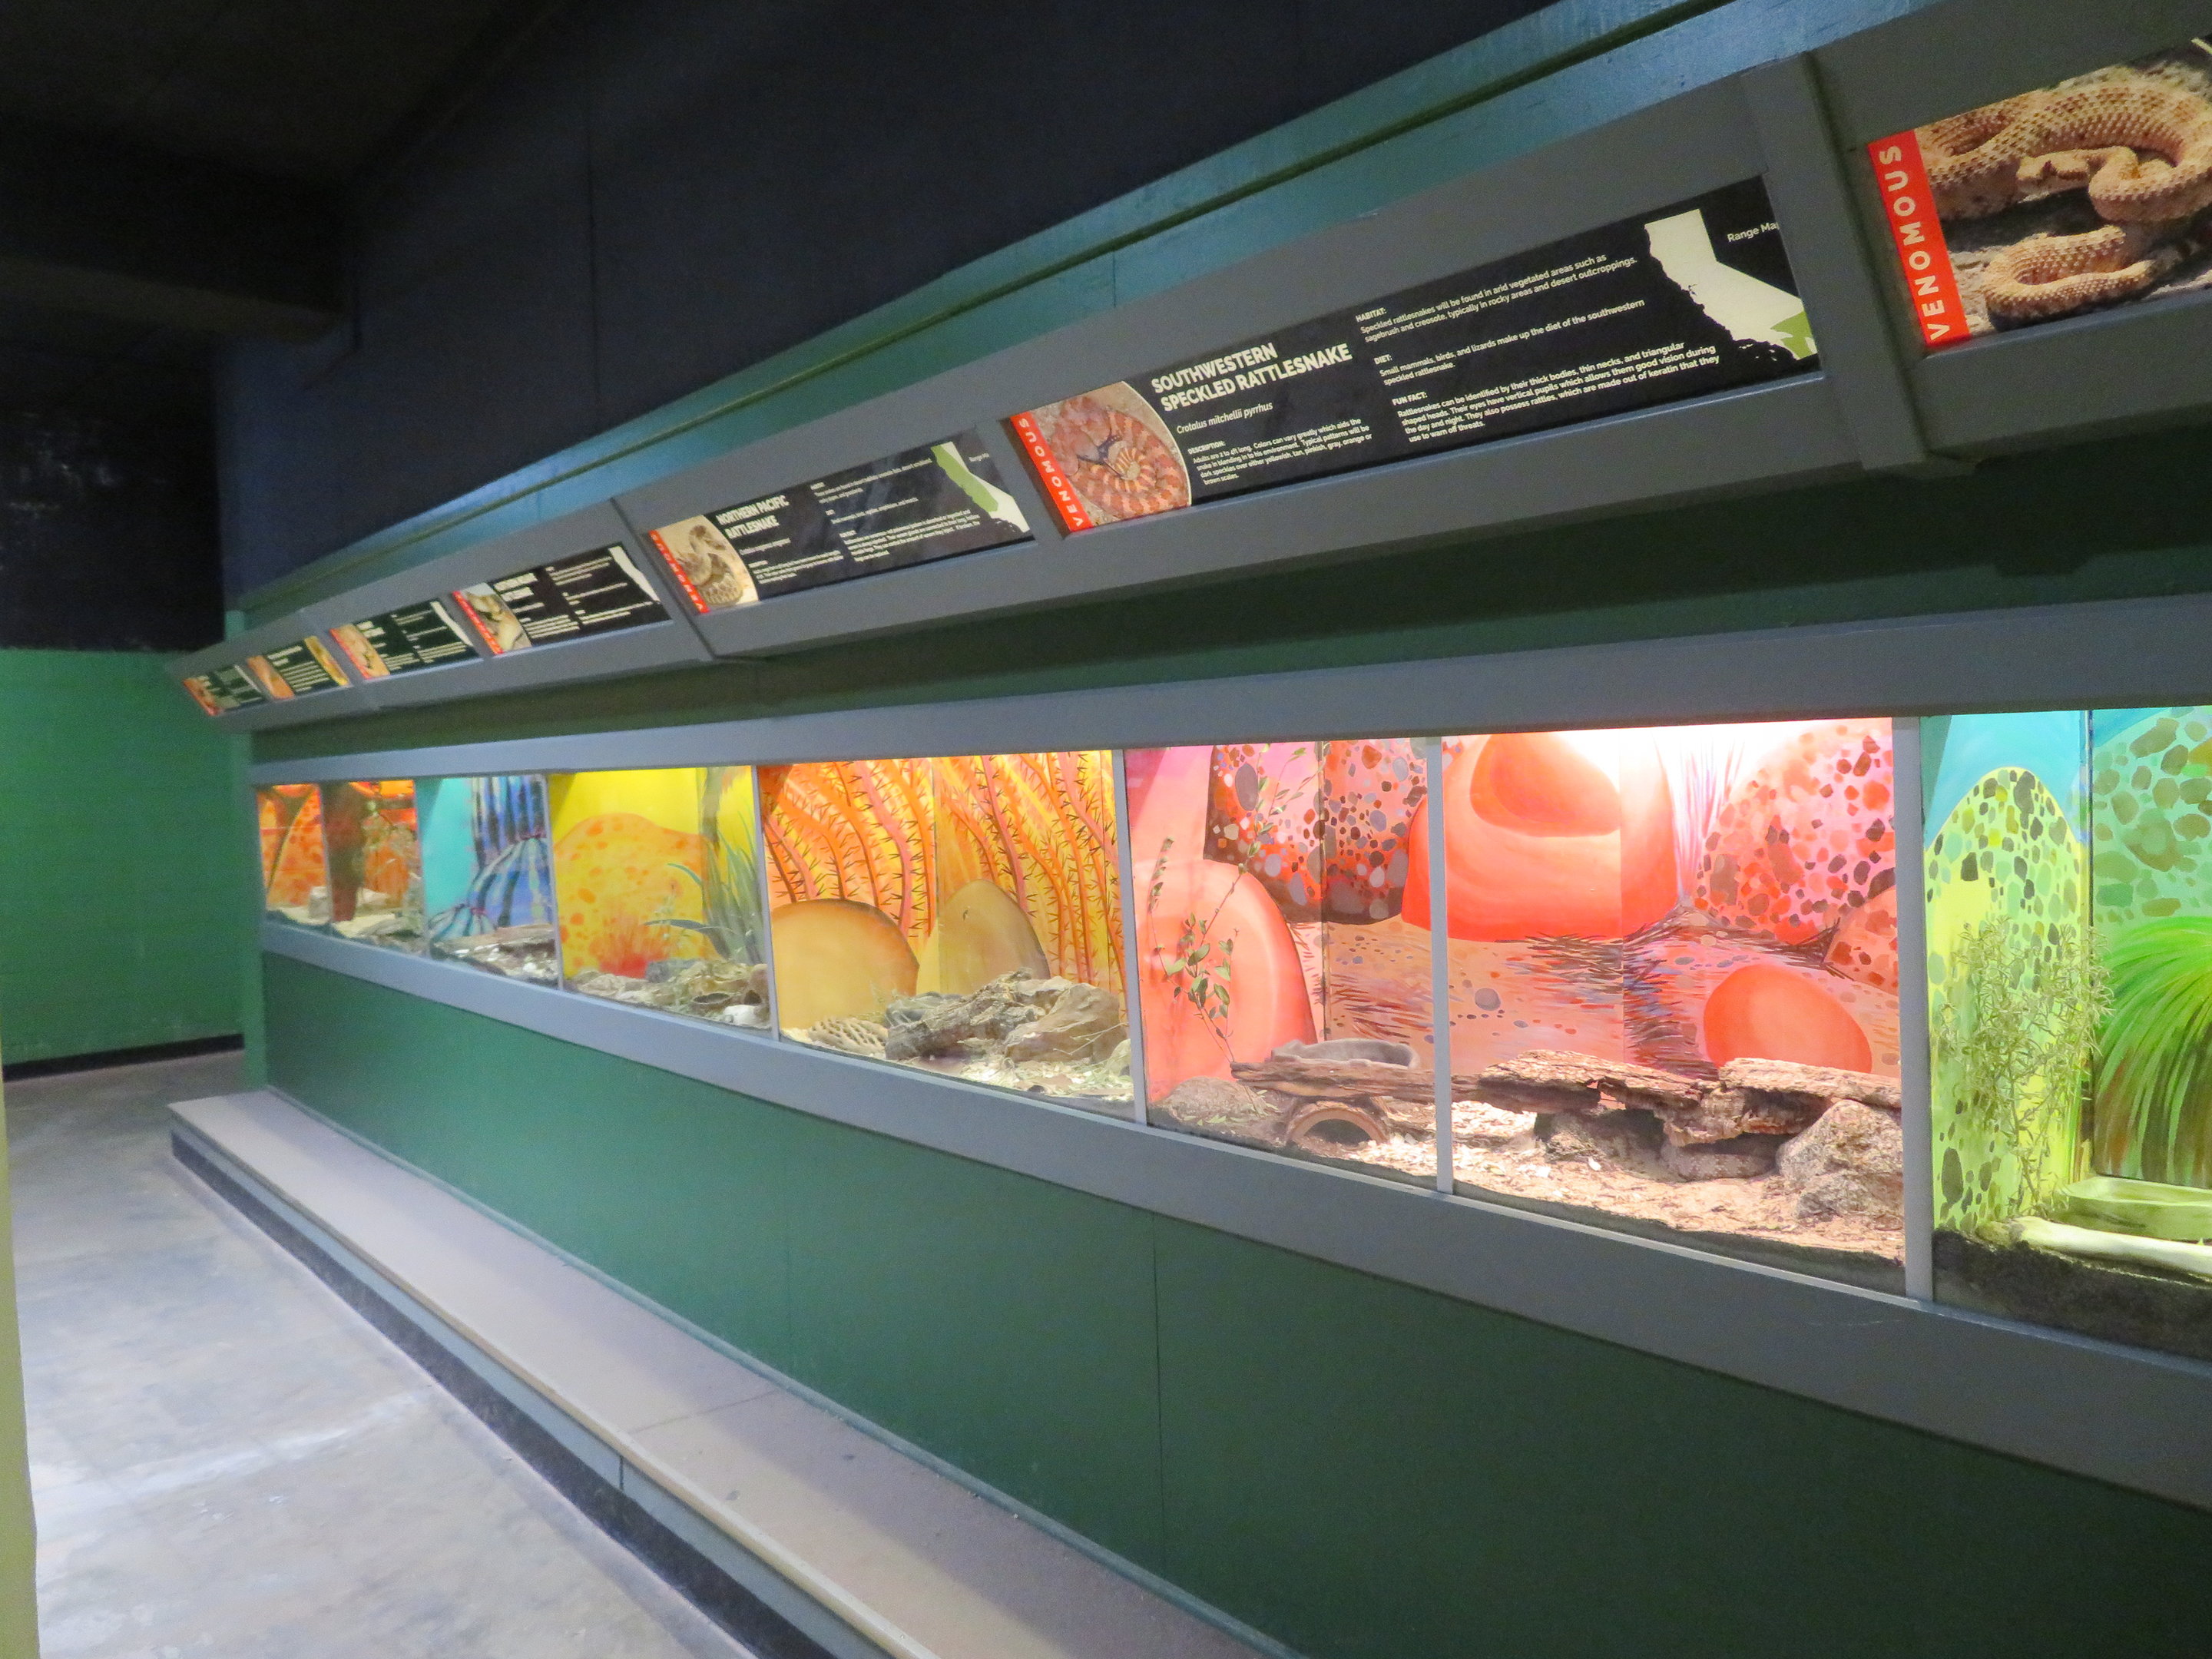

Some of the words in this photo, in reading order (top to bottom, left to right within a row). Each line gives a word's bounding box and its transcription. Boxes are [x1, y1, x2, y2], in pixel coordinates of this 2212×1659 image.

[1727, 227, 1760, 243] Range
[1879, 145, 1951, 341] VENOMOUS
[1355, 307, 1387, 323] HABITAT:
[1360, 318, 1393, 334] Speckled
[1392, 306, 1436, 325] rattlesnakes
[1435, 300, 1451, 311] will
[1449, 299, 1461, 307] be
[1460, 290, 1485, 303] found
[1483, 289, 1493, 297] in
[1492, 283, 1509, 294] arid
[1508, 270, 1551, 289] vegetated
[1550, 264, 1574, 277] areas
[1574, 257, 1595, 270] such
[1595, 254, 1607, 263] as
[1364, 326, 1400, 343] sagebrush
[1399, 321, 1415, 333] and
[1447, 303, 1479, 320] typically
[1488, 294, 1510, 306] rocky
[1510, 287, 1534, 300] areas
[1533, 281, 1550, 293] and
[1550, 273, 1578, 288] desert
[1578, 257, 1637, 280] outcroppings.
[1373, 353, 1392, 365] DIET:
[1379, 366, 1400, 377] Small
[1456, 346, 1472, 356] and
[1470, 339, 1497, 353] lizards
[1496, 334, 1518, 346] make
[1518, 331, 1531, 340] up
[1530, 327, 1545, 336] the
[1545, 321, 1562, 333] diet
[1561, 317, 1571, 327] of
[1571, 316, 1587, 325] the
[1587, 300, 1645, 321] southwestern
[1151, 342, 1278, 394] SOUTHWESTERN
[1161, 378, 1237, 412] SPECKLED
[1234, 343, 1353, 391] RATTLESNAKE
[1383, 371, 1415, 386] speckled
[1414, 362, 1455, 377] rattlesnake.
[1396, 402, 1442, 418] Rattlesnakes
[1441, 399, 1455, 408] can
[1464, 386, 1501, 402] identified
[1498, 386, 1510, 394] by
[1509, 380, 1528, 390] their
[1528, 375, 1550, 386] thick
[1578, 363, 1596, 374] thin
[1624, 351, 1641, 363] and
[1641, 342, 1684, 359] triangular
[1401, 414, 1428, 426] shaped
[1426, 409, 1451, 420] heads.
[1449, 404, 1469, 415] Their
[1469, 401, 1487, 411] eyes
[1485, 396, 1505, 406] have
[1505, 388, 1535, 402] vertical
[1534, 382, 1559, 396] pupils
[1558, 376, 1584, 389] which
[1584, 371, 1611, 382] allows
[1611, 365, 1635, 376] them
[1634, 358, 1658, 372] good
[1658, 353, 1685, 365] vision
[1685, 346, 1717, 359] during
[1392, 396, 1409, 406] FUN
[1407, 391, 1428, 402] FACT:
[1404, 426, 1417, 435] the
[1417, 423, 1430, 432] day
[1430, 419, 1445, 429] and
[1444, 415, 1465, 426] night.
[1464, 411, 1483, 420] They
[1483, 407, 1500, 416] also
[1500, 400, 1531, 414] possess
[1558, 387, 1583, 399] which
[1582, 385, 1597, 393] are
[1597, 378, 1622, 389] made
[1622, 374, 1638, 384] out
[1637, 370, 1647, 380] of
[1647, 364, 1679, 378] keratin
[1678, 359, 1699, 370] that
[1698, 355, 1720, 366] they
[1176, 420, 1208, 434] Crotalus
[1207, 408, 1243, 426] mitchellii
[1240, 402, 1273, 419] pyrrhus
[1408, 435, 1422, 443] use
[1429, 429, 1449, 438] warn
[1447, 425, 1458, 434] off
[1457, 420, 1485, 432] threats.
[1187, 440, 1226, 455] DESCRIPTION:
[1193, 455, 1211, 464] Adults
[1253, 440, 1273, 449] Colors
[1296, 428, 1318, 440] greatly
[1317, 423, 1337, 434] which
[1336, 420, 1351, 429] aids
[1196, 462, 1213, 472] snake
[1217, 456, 1243, 466] blending
[1300, 435, 1323, 447] Typical
[1322, 430, 1349, 443] patterns
[1348, 426, 1362, 435] will
[1200, 470, 1214, 478] dark
[1212, 465, 1237, 476] speckles
[1247, 459, 1265, 468] either
[1342, 435, 1365, 445] orange
[1019, 418, 1084, 527] VENOMOUS
[1203, 477, 1221, 485] brown
